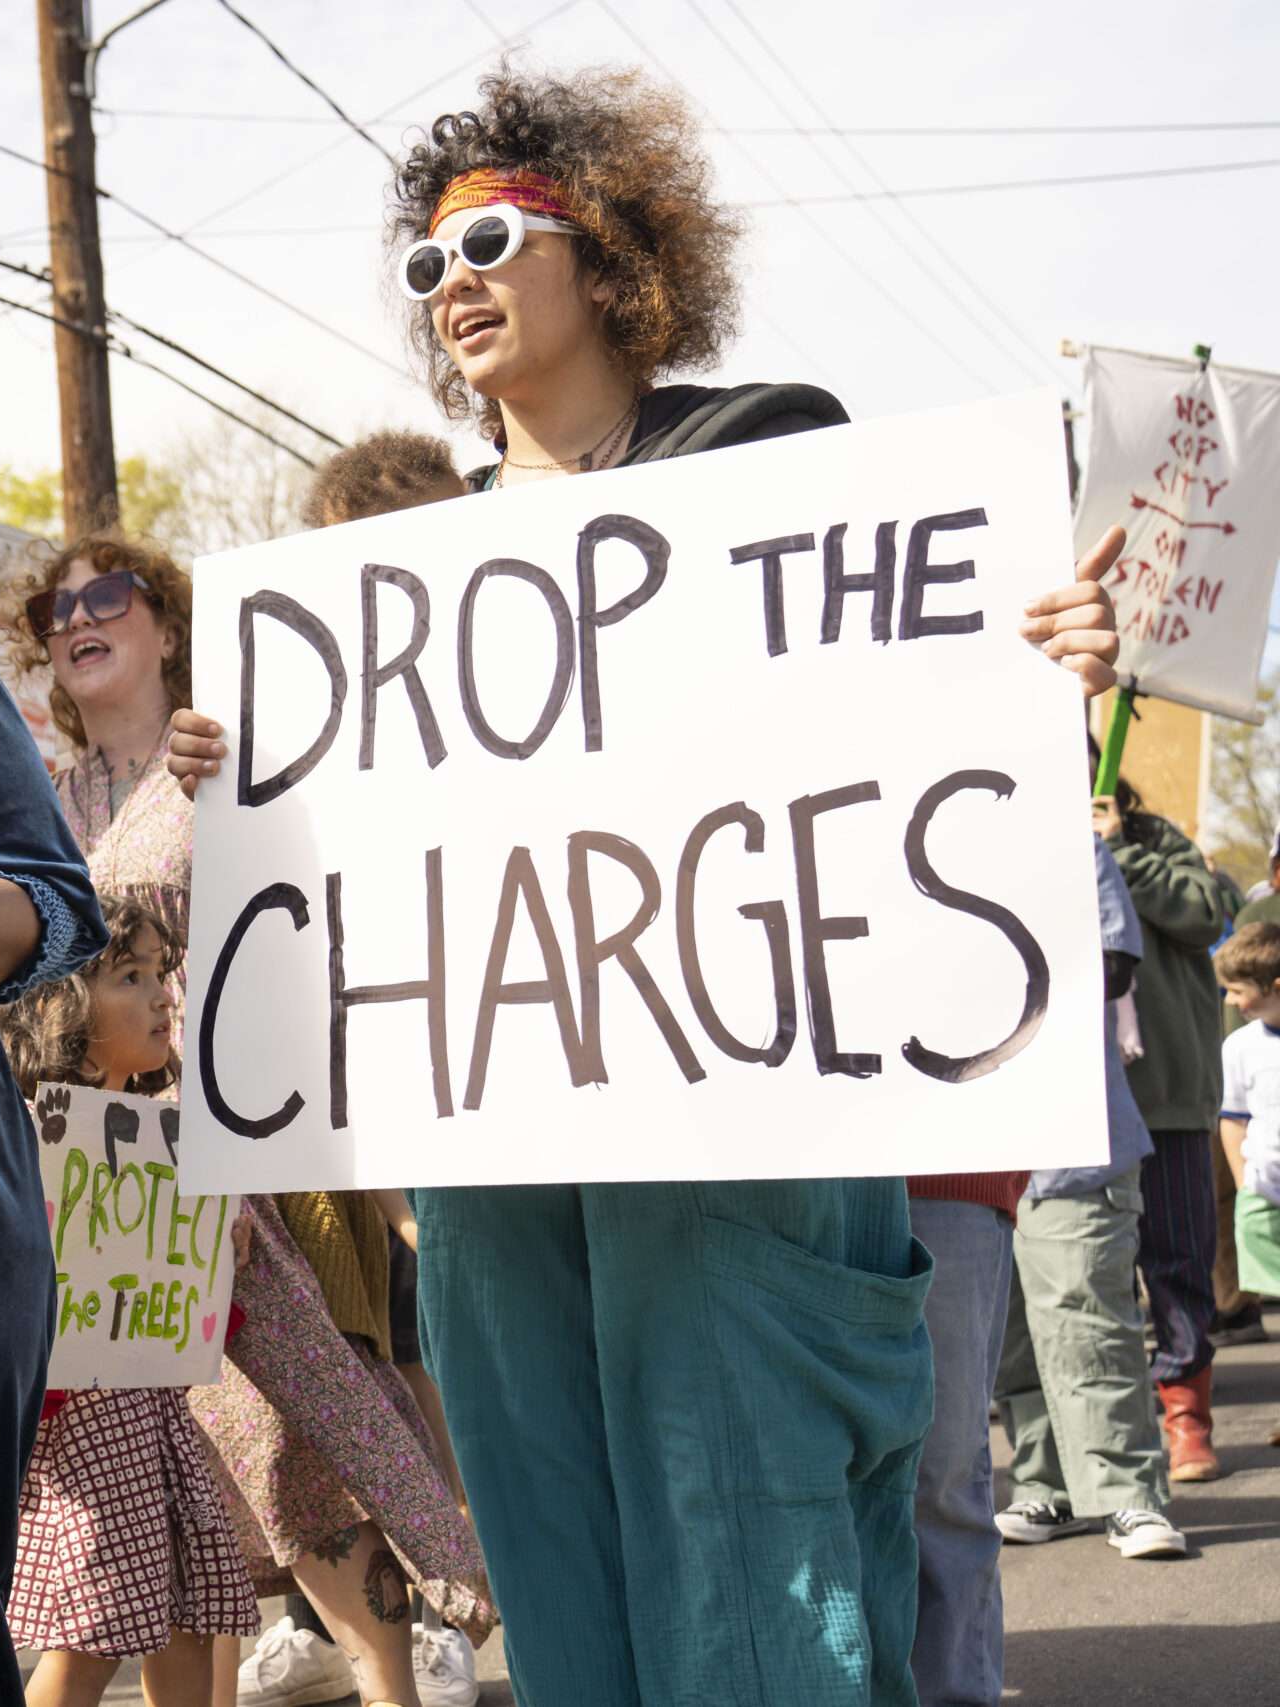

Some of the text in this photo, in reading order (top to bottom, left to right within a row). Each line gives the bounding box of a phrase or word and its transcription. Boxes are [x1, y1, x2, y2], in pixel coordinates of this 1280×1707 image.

[1175, 394, 1215, 428] NO
[1168, 429, 1218, 466] COP
[1154, 461, 1228, 508] CITY
[1156, 530, 1186, 568] ON
[1106, 557, 1223, 614] STOLEN
[1112, 598, 1190, 646] AND
[237, 507, 988, 808] DROP THE
[198, 769, 1050, 1140] CHARGES
[108, 1273, 199, 1354] TREES
